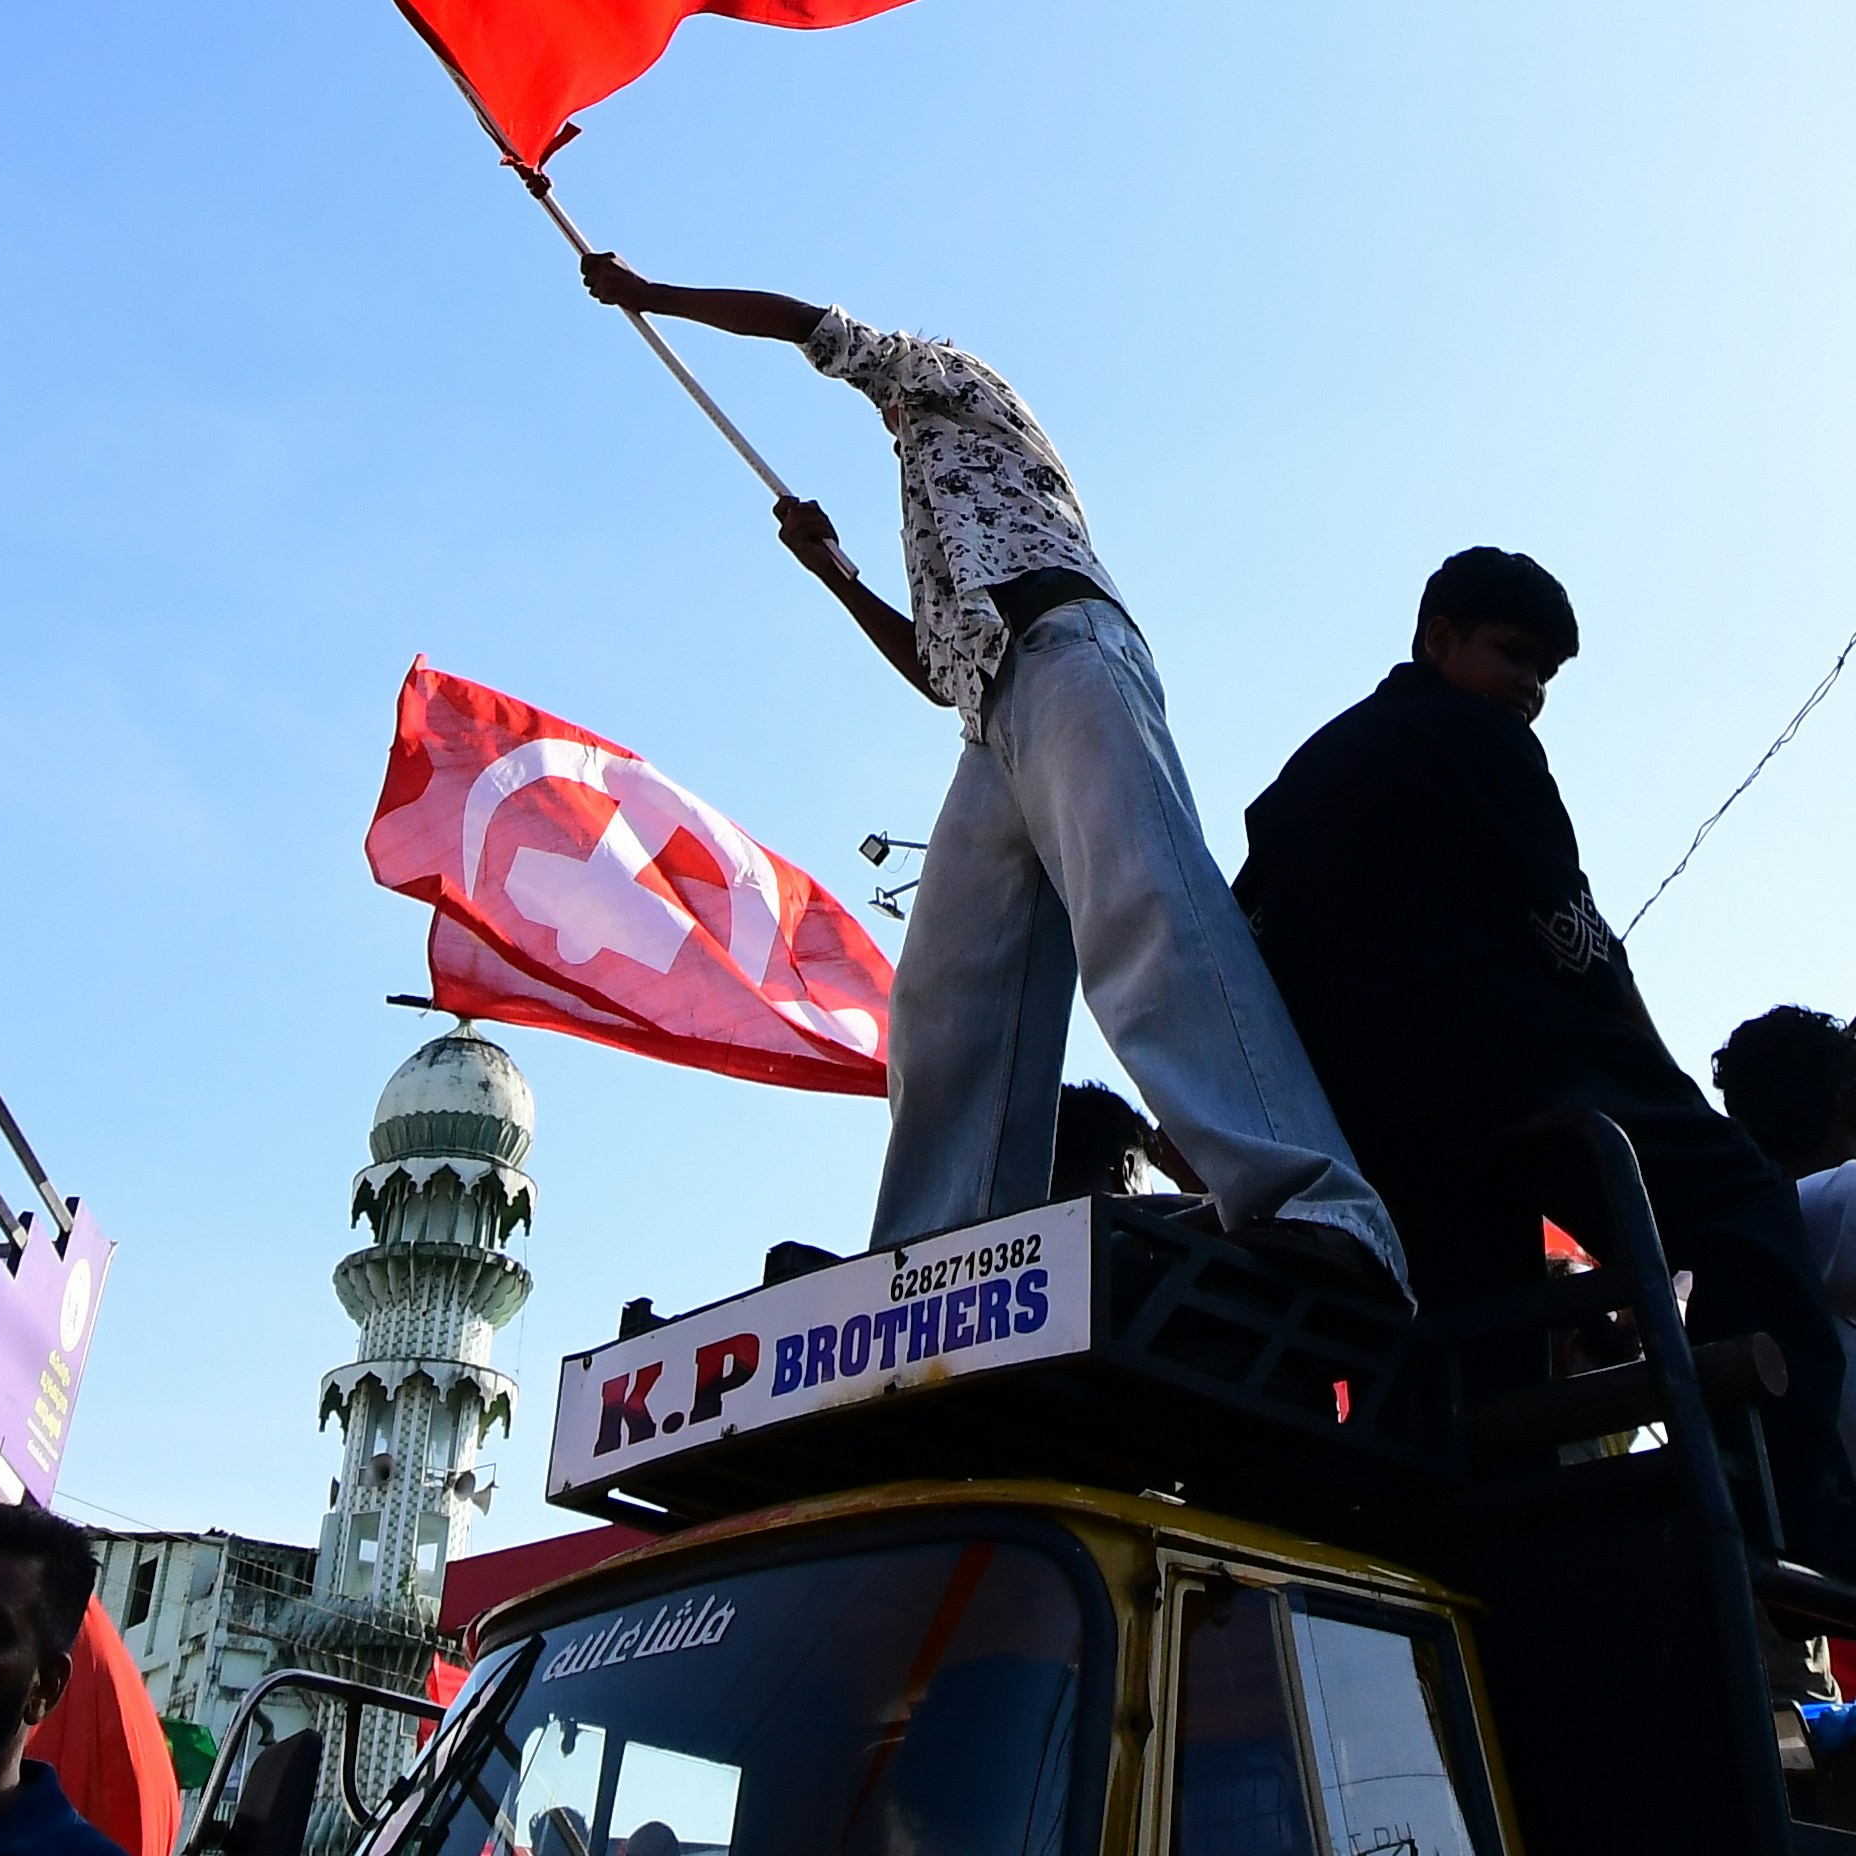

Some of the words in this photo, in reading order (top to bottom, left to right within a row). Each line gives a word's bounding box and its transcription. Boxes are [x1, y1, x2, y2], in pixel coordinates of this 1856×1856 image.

[890, 1234, 1043, 1303] 6282719382
[593, 1332, 761, 1458] K.P
[771, 1268, 1050, 1398] BROTHERS
